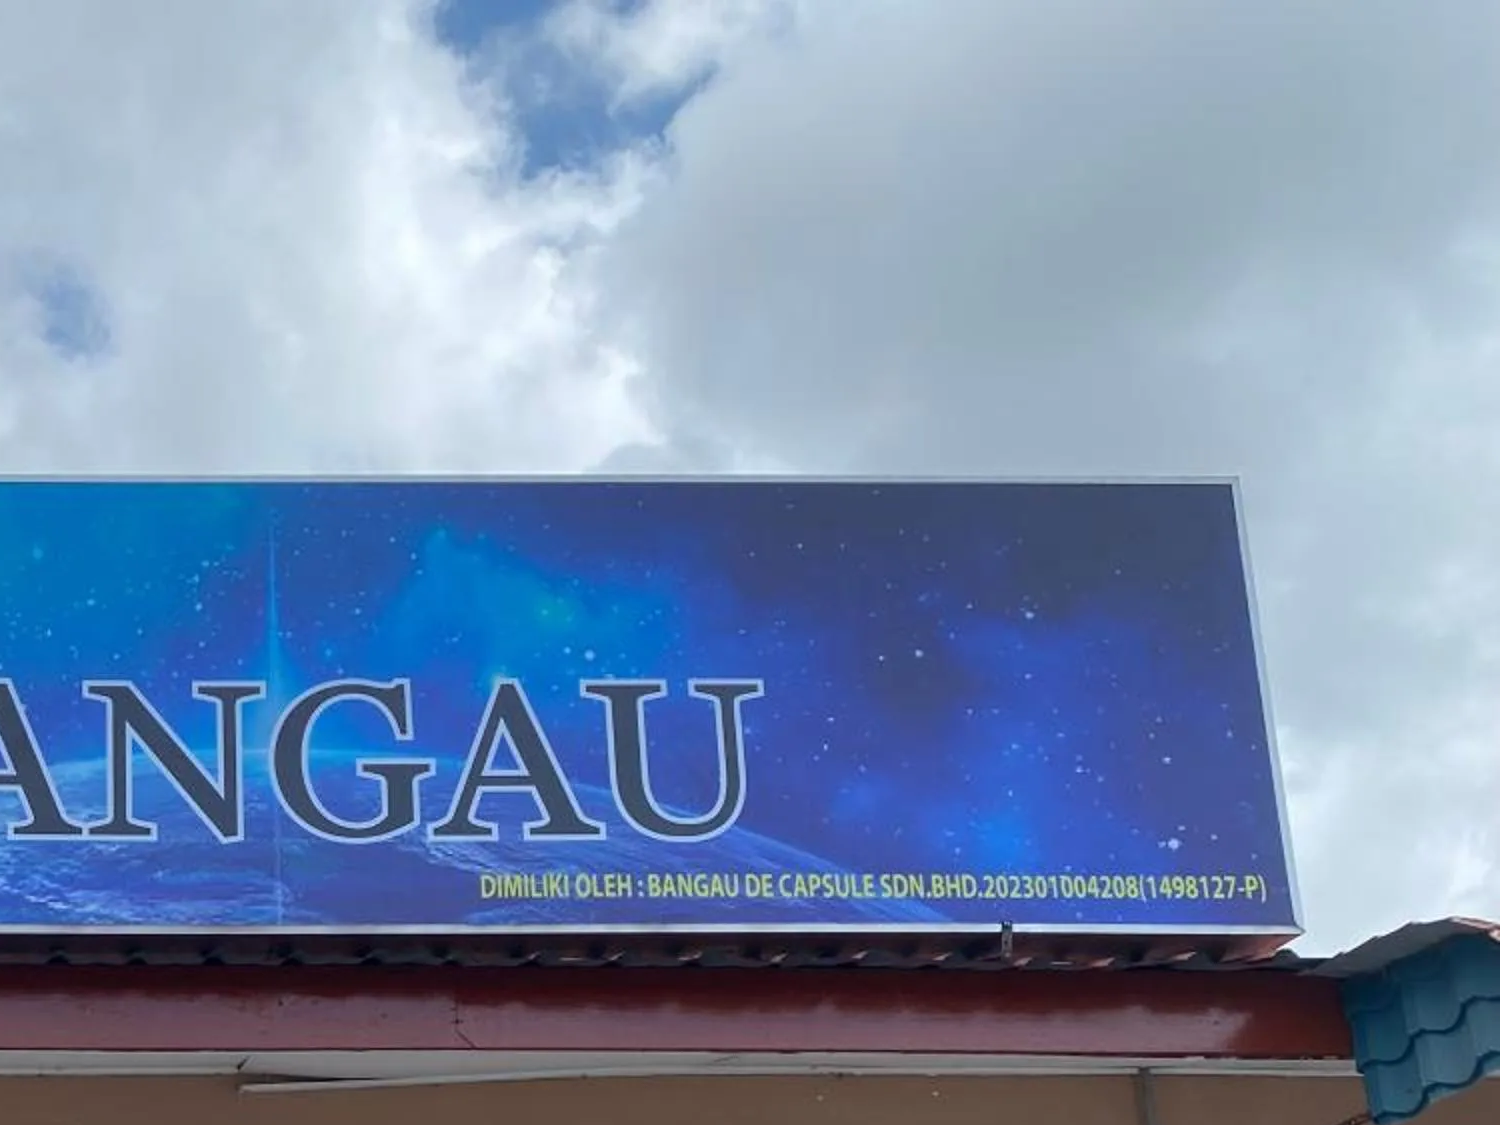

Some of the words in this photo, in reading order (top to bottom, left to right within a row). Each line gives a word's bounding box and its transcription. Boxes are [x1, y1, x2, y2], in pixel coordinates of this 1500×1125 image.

[479, 873, 570, 899] DIMILIKI
[575, 873, 633, 899] OLEH
[647, 873, 740, 899] BANGAU
[745, 873, 773, 898] DE
[778, 873, 874, 899] CAPSULE
